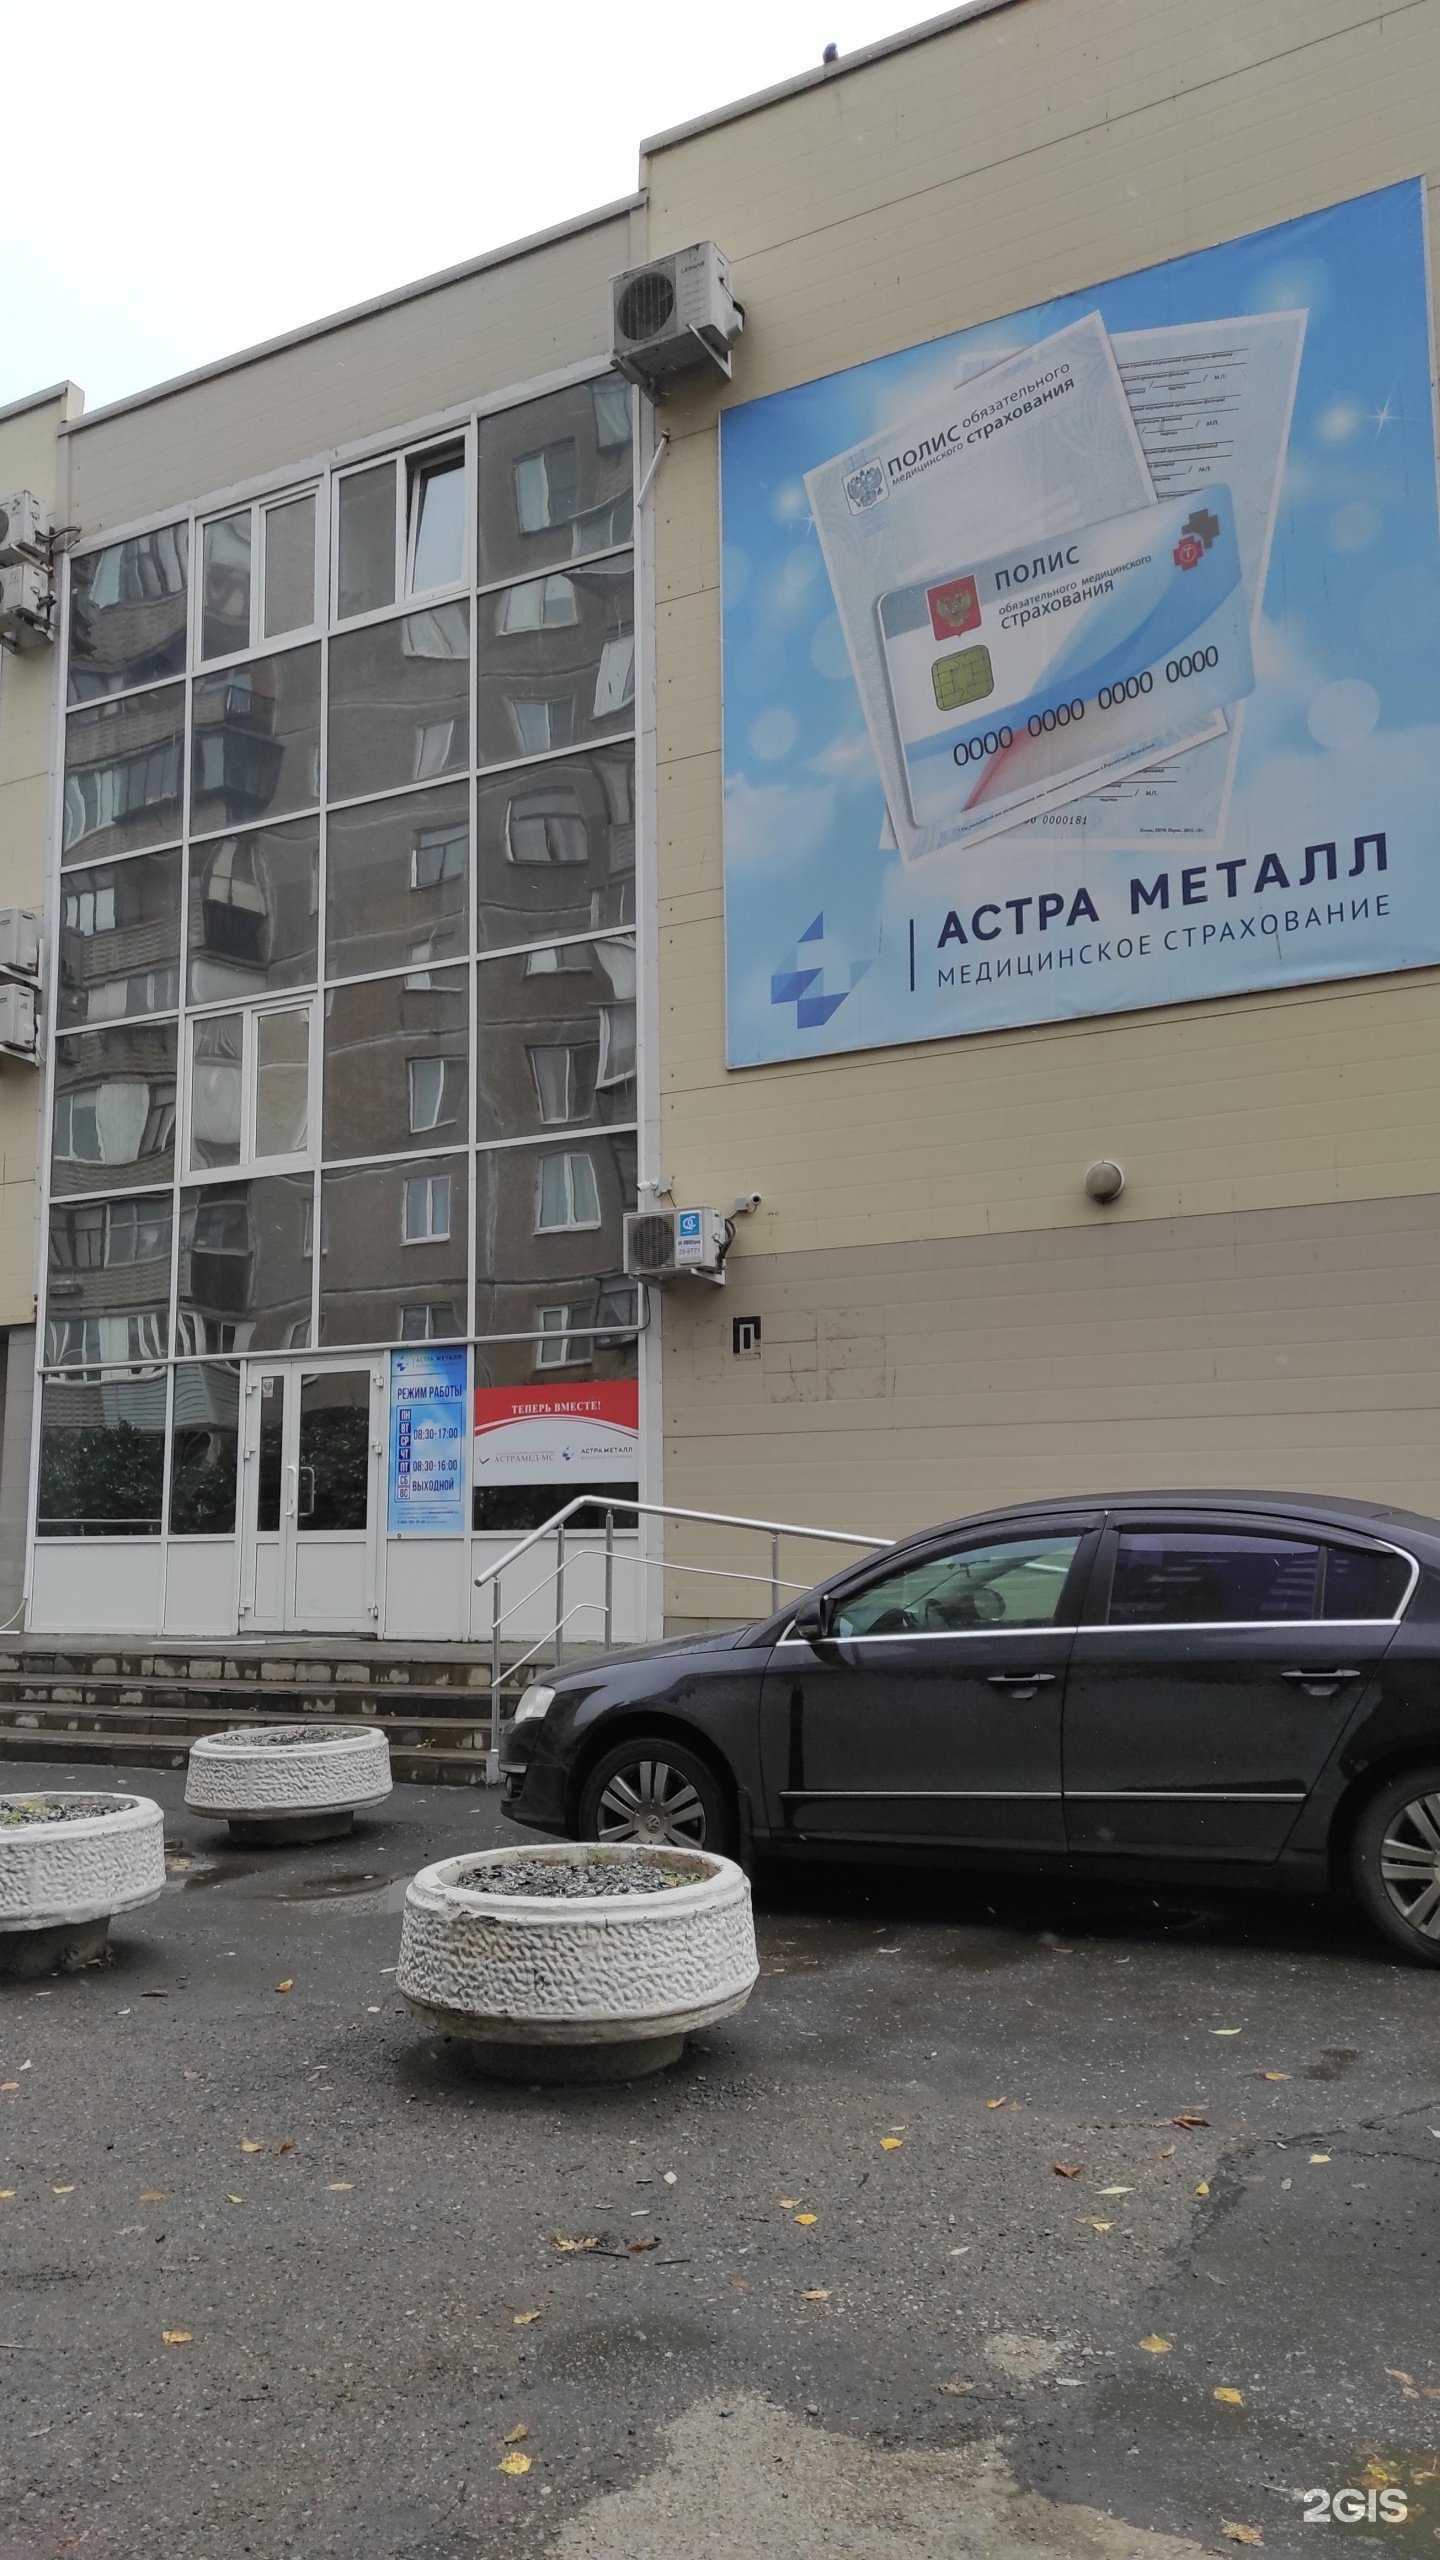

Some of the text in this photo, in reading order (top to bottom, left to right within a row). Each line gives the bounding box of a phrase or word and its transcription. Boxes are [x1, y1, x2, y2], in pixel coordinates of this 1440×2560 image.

[887, 363, 1070, 476] ПОЛИС обязательного
[892, 378, 1075, 486] медицинского страхования
[995, 545, 1080, 591] ПОЛИС
[998, 555, 1152, 616] обязательного медицинского
[1001, 579, 1114, 630] страхования
[953, 645, 1219, 766] 0000 0000 0000 0000
[937, 832, 1388, 949] АСТРА МЕТАЛЛ
[938, 894, 1391, 988] МЕДИЦИНСКОЕ СТРАХОВАНИЕ
[397, 1384, 462, 1400] РЕЖИМ РАБОТЫ
[512, 1400, 601, 1414] ТЕПЕРЬ ВМЕСТЕ!
[401, 1423, 410, 1433] ВТ
[400, 1436, 409, 1446] СР
[400, 1449, 409, 1459] ЧТ
[400, 1462, 409, 1472] ПТ
[400, 1475, 408, 1485] СБ
[412, 1478, 454, 1492] ВЫХОДНОЙ
[400, 1488, 408, 1498] ВС
